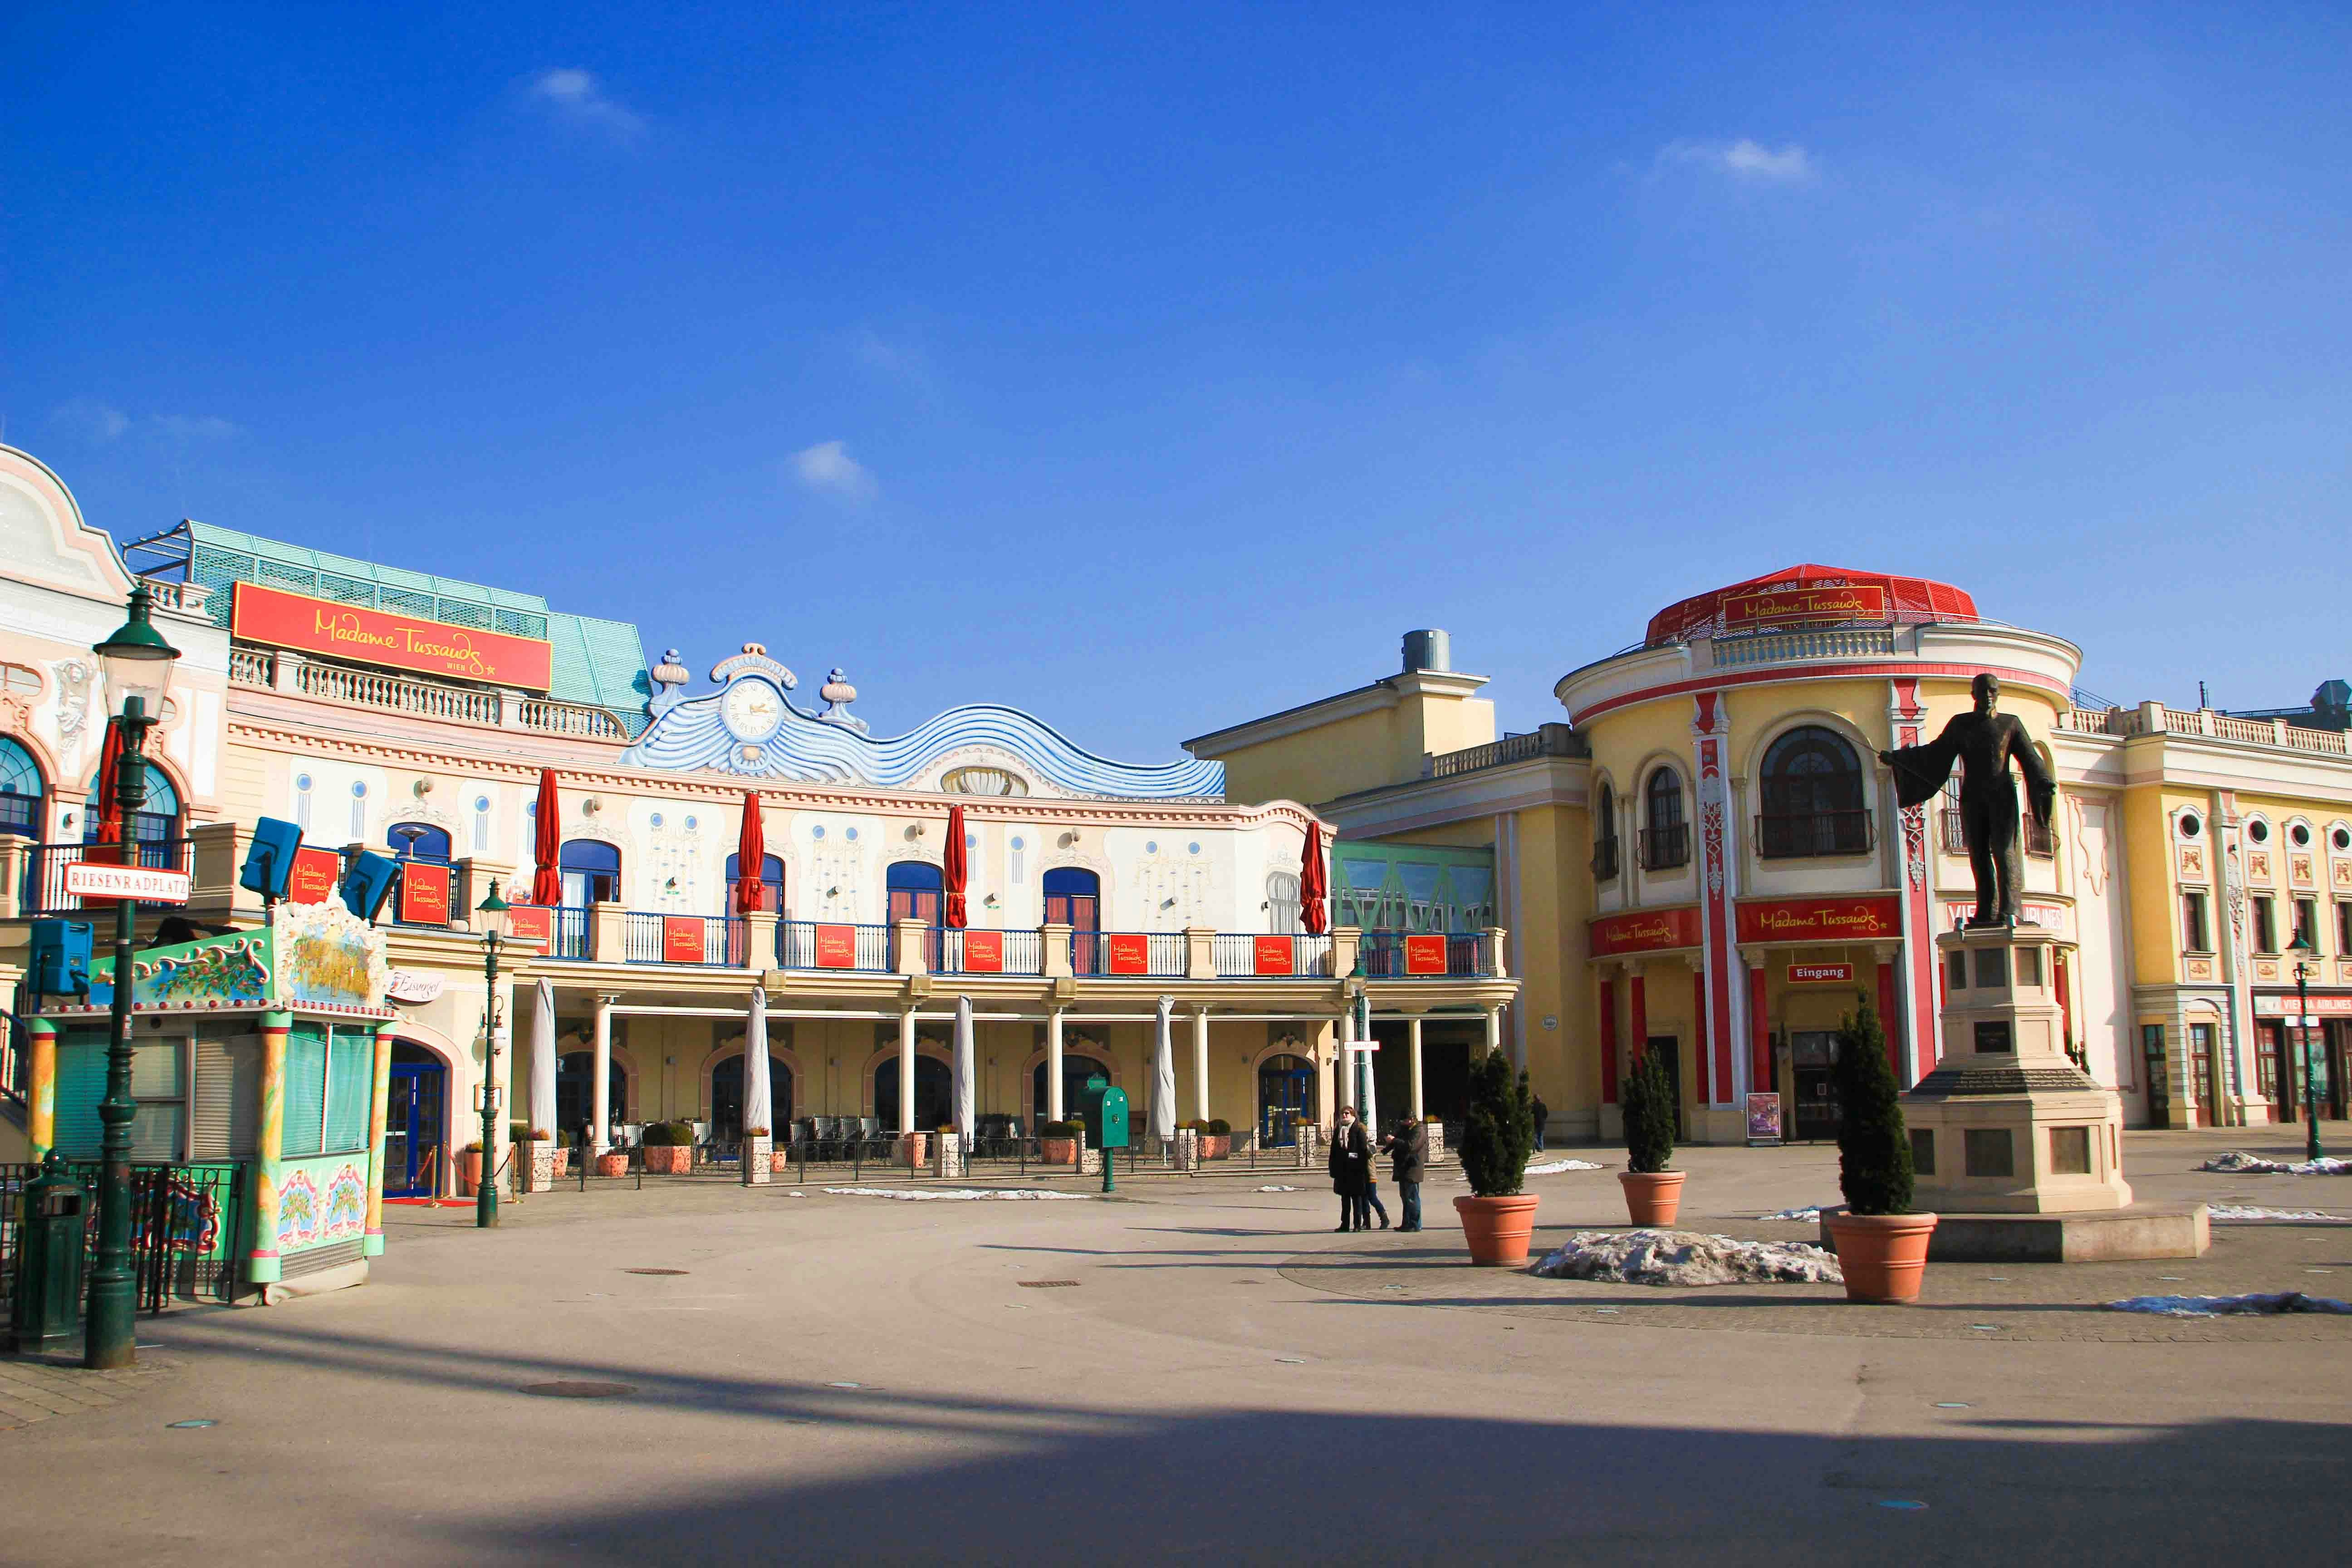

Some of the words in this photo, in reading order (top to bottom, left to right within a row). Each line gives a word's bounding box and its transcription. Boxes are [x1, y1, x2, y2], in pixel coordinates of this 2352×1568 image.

[1745, 598, 1803, 617] Madame
[1799, 591, 1866, 616] Tussauds
[315, 609, 399, 649] Madame
[394, 627, 484, 676] Tussauds
[446, 662, 466, 671] WIEN
[297, 863, 327, 878] Madame
[72, 872, 186, 894] RIESENRADPLATZ
[409, 878, 438, 892] Madame
[410, 891, 441, 910] Tussauds
[513, 918, 541, 929] Madame
[1761, 910, 1817, 929] Madame
[1813, 906, 1879, 931] Tussauds
[669, 927, 696, 938] Madame
[1630, 919, 1671, 942] Tussauds
[669, 937, 699, 951] Tussauds
[968, 941, 994, 950] Madame
[1113, 944, 1139, 953] Madame
[1258, 945, 1284, 954] Madame
[1797, 969, 1844, 979] Eingang
[389, 972, 441, 999] Eisvogel
[2316, 1000, 2352, 1009] AIRLINES
